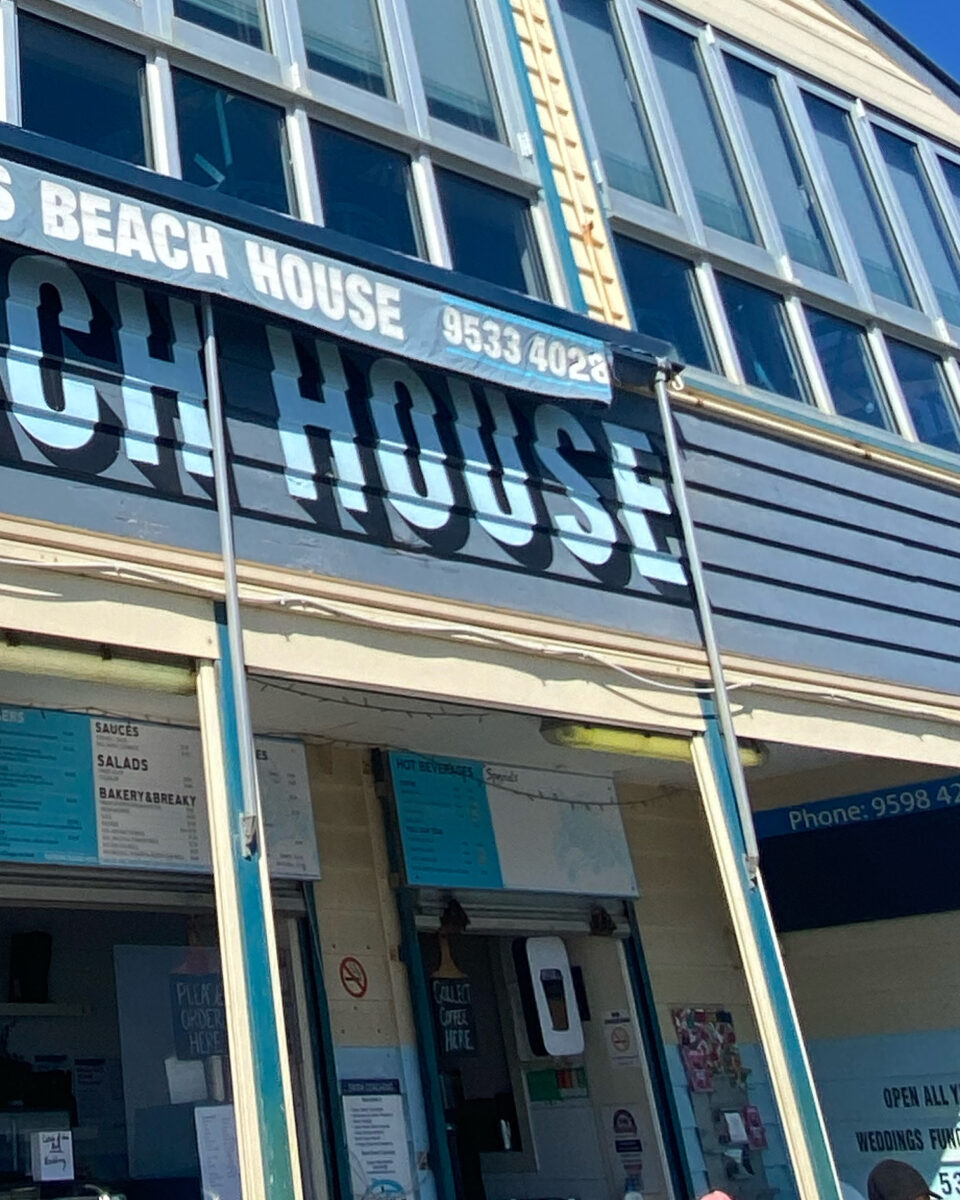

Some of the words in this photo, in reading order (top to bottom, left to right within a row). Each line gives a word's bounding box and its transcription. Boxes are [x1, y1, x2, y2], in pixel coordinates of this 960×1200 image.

[39, 180, 229, 280] BEACH
[245, 239, 406, 341] HOUSE
[442, 306, 522, 366] 9533
[528, 334, 610, 385] 4028
[265, 323, 689, 587] HOUSE
[95, 721, 139, 737] SAUCES
[97, 754, 149, 771] SALADS
[396, 759, 418, 771] HOT
[788, 804, 869, 831] Phone:
[871, 788, 932, 817] 9598
[180, 1007, 224, 1031] ORDER
[188, 1031, 224, 1056] HERE
[444, 1028, 475, 1052] HERE
[882, 1085, 920, 1109] OPEN
[923, 1084, 950, 1107] ALL
[949, 1082, 960, 1106] Y
[855, 1128, 925, 1153] WEDDINGS
